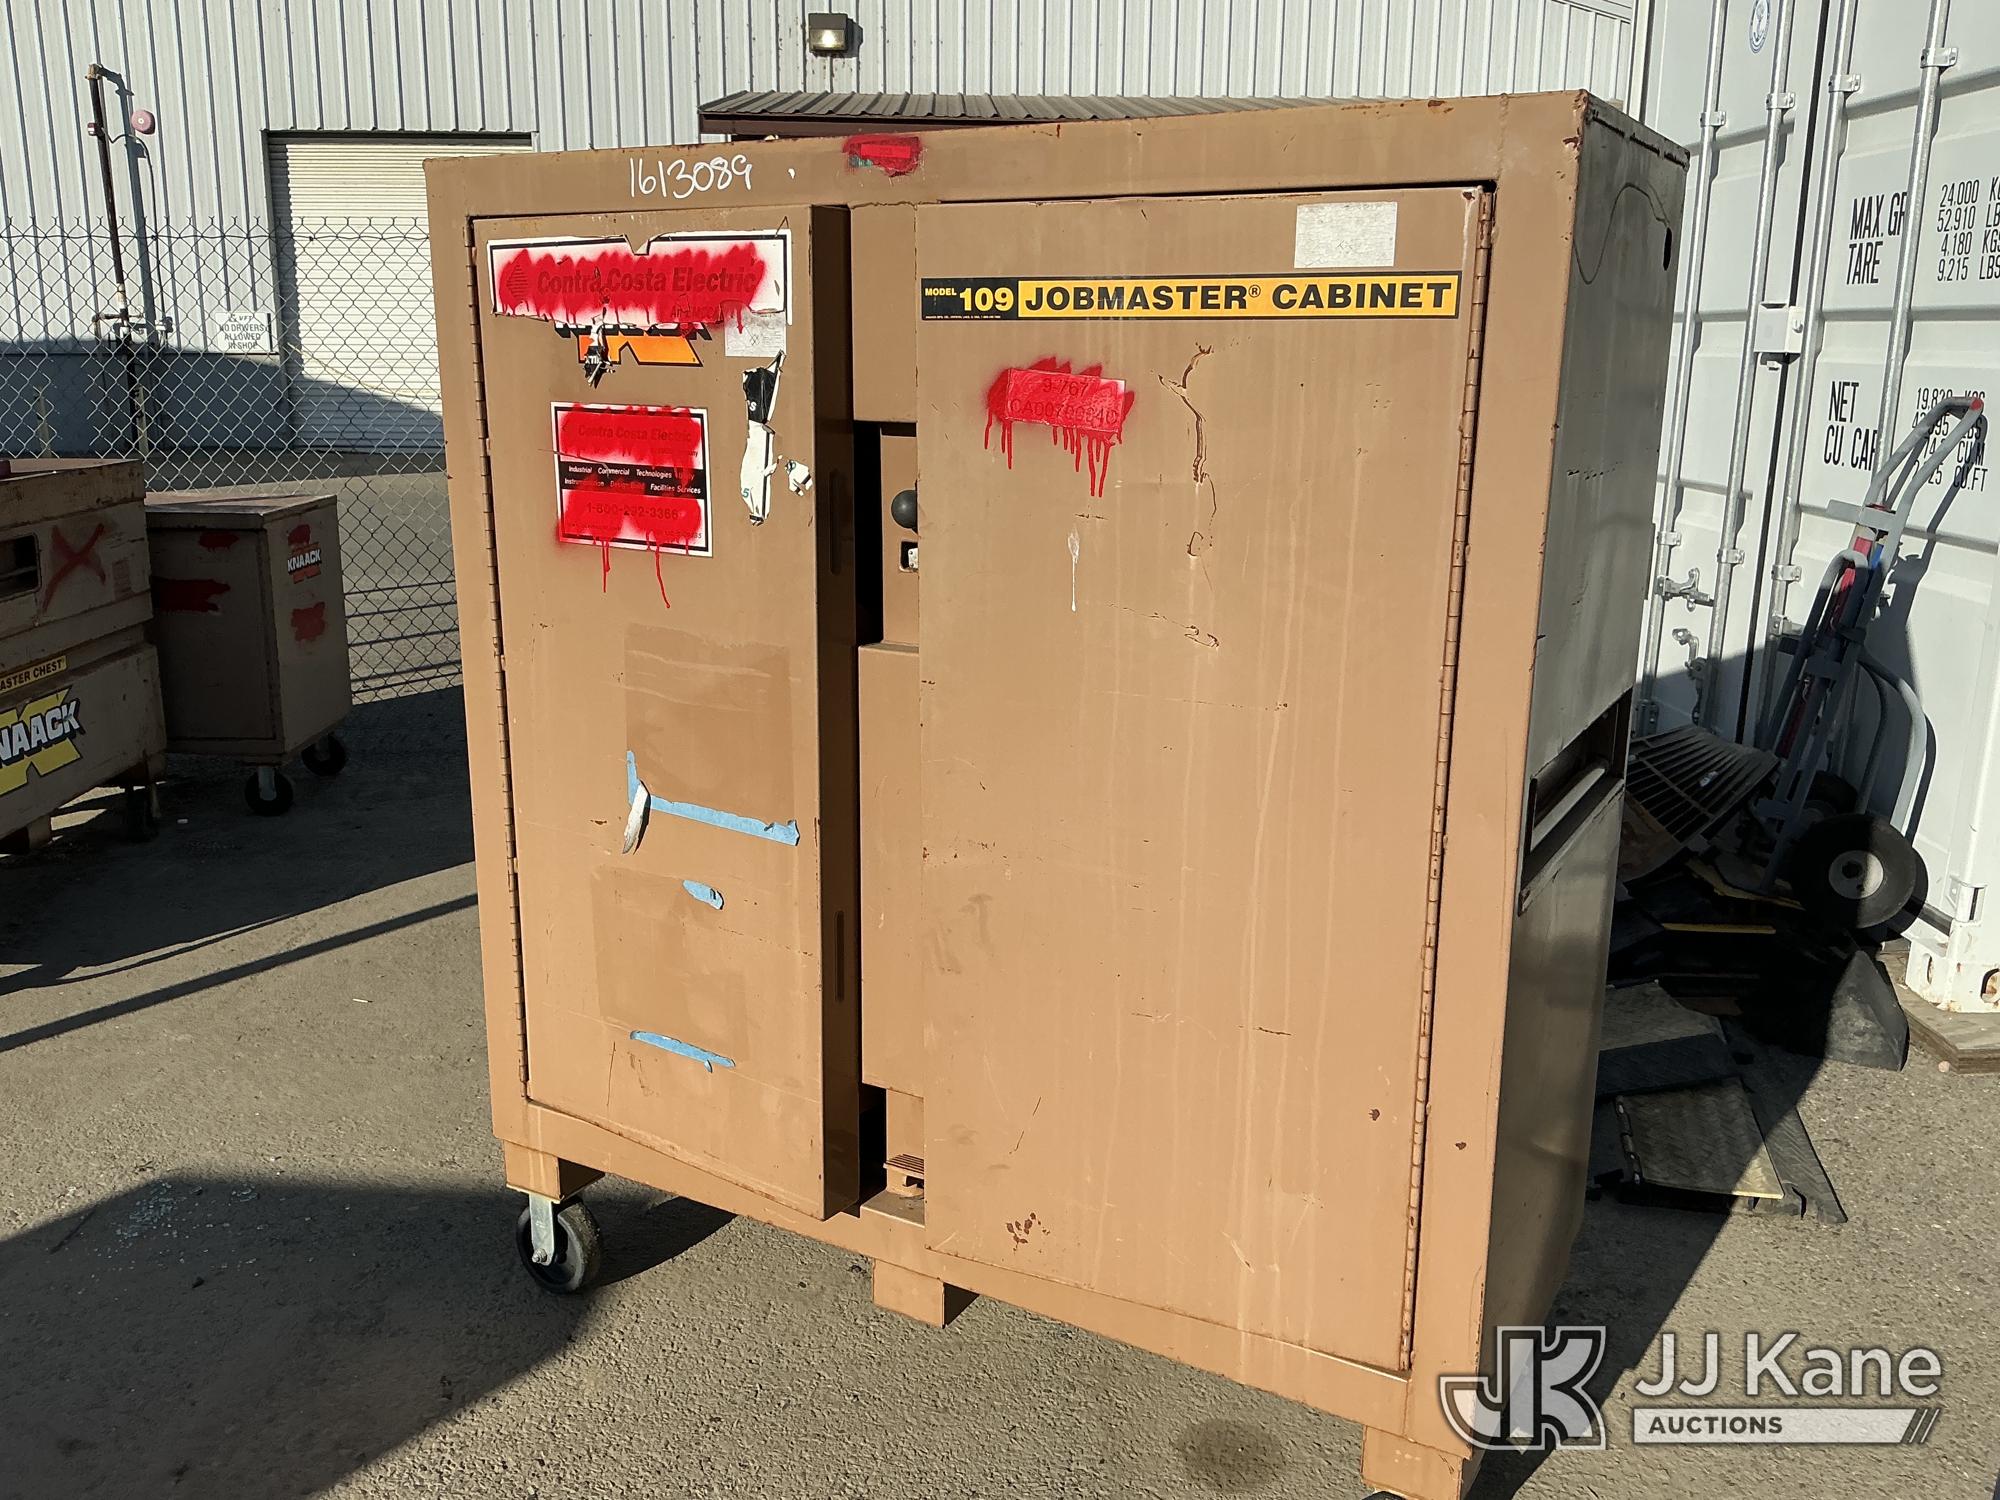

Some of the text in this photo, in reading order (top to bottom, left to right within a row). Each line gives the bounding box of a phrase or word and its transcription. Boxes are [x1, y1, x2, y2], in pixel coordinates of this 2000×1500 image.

[1850, 194, 1885, 240] MAX.
[1846, 241, 1883, 285] TARE
[537, 265, 757, 295] Contra Costa Electric
[924, 287, 957, 296] MODEL
[959, 287, 1014, 312] 109
[1272, 282, 1452, 310] CABINET
[225, 332, 261, 341] ALLOWED
[1828, 381, 1859, 423] NET
[568, 465, 593, 474] Industrial
[597, 466, 630, 476] Commercial
[636, 468, 672, 480] Technologies
[287, 548, 321, 573] KNAACK
[33, 659, 63, 678] CHEST
